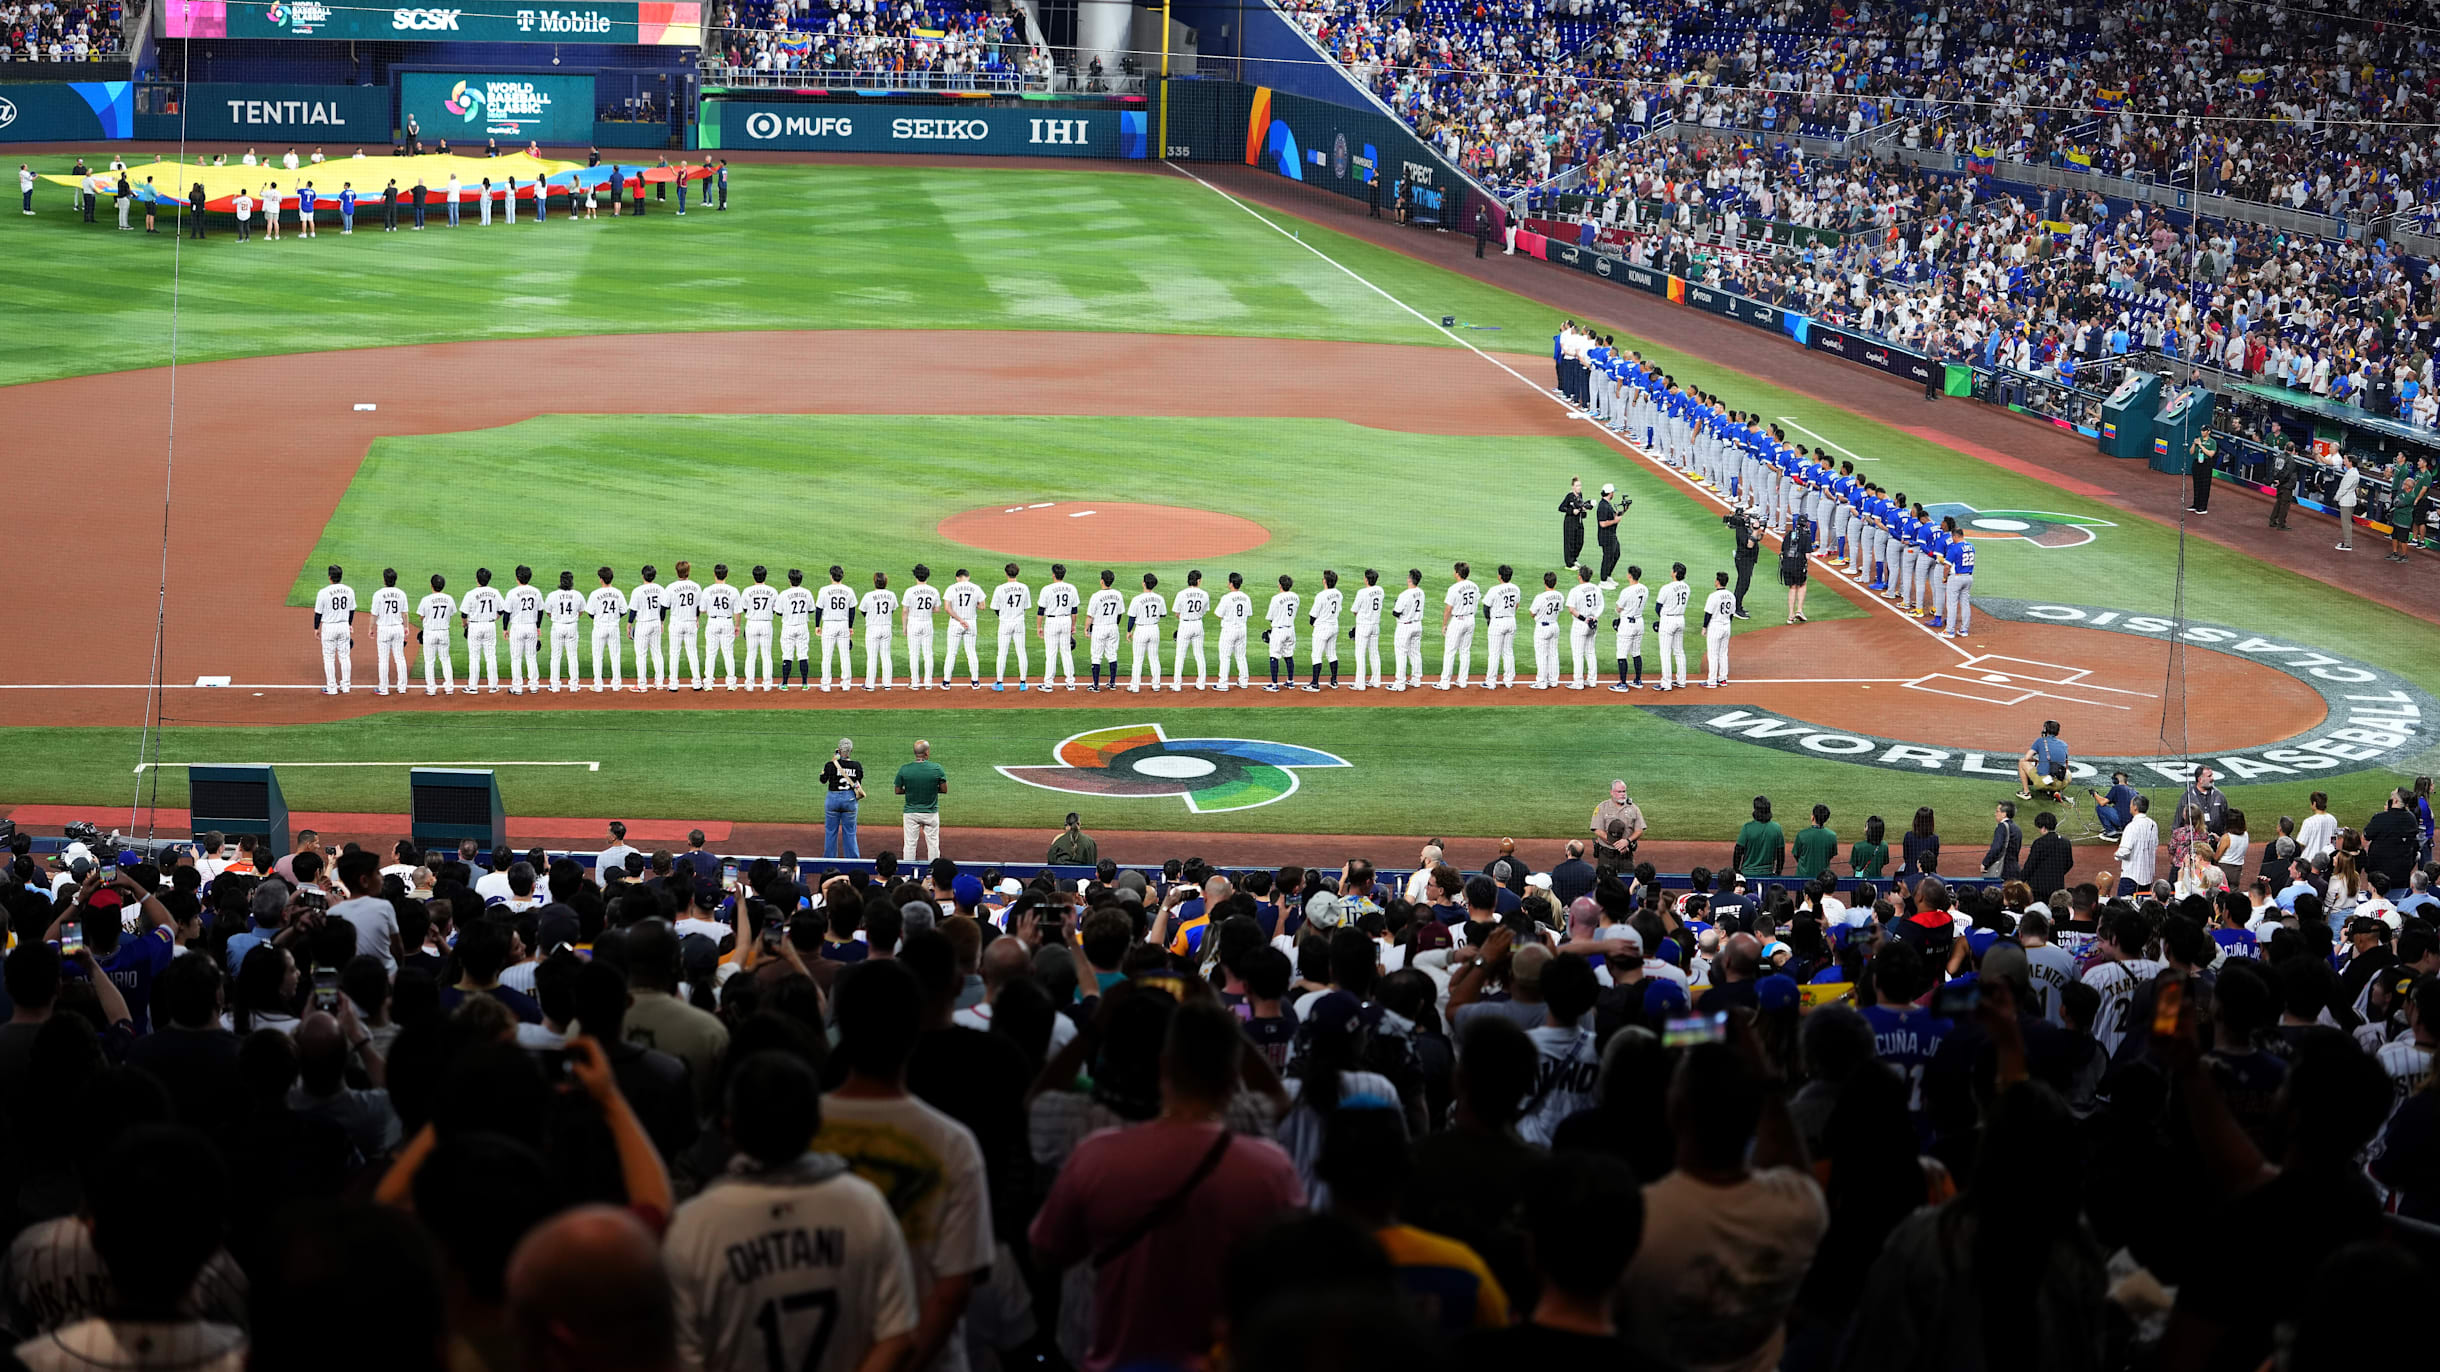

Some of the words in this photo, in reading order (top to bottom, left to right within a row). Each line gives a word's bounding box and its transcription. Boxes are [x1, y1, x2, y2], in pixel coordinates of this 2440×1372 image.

[392, 8, 461, 30] SCSK
[539, 10, 611, 32] Mobile
[486, 82, 534, 93] WORLD
[486, 93, 551, 104] BASEBALL
[227, 100, 345, 125] TENTIAL
[786, 117, 852, 137] MUFG
[892, 118, 988, 140] SEIKO
[1029, 118, 1089, 145] IHI
[1167, 146, 1190, 157] 335
[1395, 180, 1442, 211] EYTHING
[1628, 269, 1652, 287] KONAMI
[1962, 552, 1975, 567] 22
[332, 596, 347, 611] 88
[521, 597, 535, 611] 23
[647, 595, 658, 610] 15
[680, 592, 694, 607] 28
[714, 596, 729, 610] 46
[753, 597, 769, 610] 57
[831, 596, 846, 610] 66
[917, 597, 932, 610] 26
[959, 593, 971, 607] 17
[1007, 594, 1022, 608] 47
[1056, 593, 1068, 607] 19
[1372, 597, 1379, 611] 6
[1462, 591, 1474, 606] 55
[1503, 594, 1516, 609] 25
[1585, 593, 1597, 608] 51
[1638, 595, 1643, 608] 7
[1676, 591, 1687, 606] 16
[385, 600, 398, 614] 79
[433, 605, 447, 619] 77
[480, 599, 493, 614] 71
[560, 601, 573, 615] 14
[603, 600, 616, 614] 24
[791, 600, 806, 614] 22
[877, 601, 889, 615] 13
[1103, 602, 1116, 616] 27
[1145, 604, 1157, 618] 12
[1187, 600, 1202, 613] 20
[1236, 603, 1243, 617] 8
[1287, 603, 1294, 617] 5
[1414, 599, 1421, 613] 2
[1546, 601, 1560, 616] 34
[2026, 605, 2378, 683] CLASSIC
[2142, 689, 2422, 784] BASEBALL
[1715, 905, 1742, 914] BEST
[2225, 942, 2248, 958] CUÑA
[1875, 1029, 1918, 1056] CUÑA
[727, 1228, 845, 1284] OHTANI
[756, 1287, 837, 1372] 17
